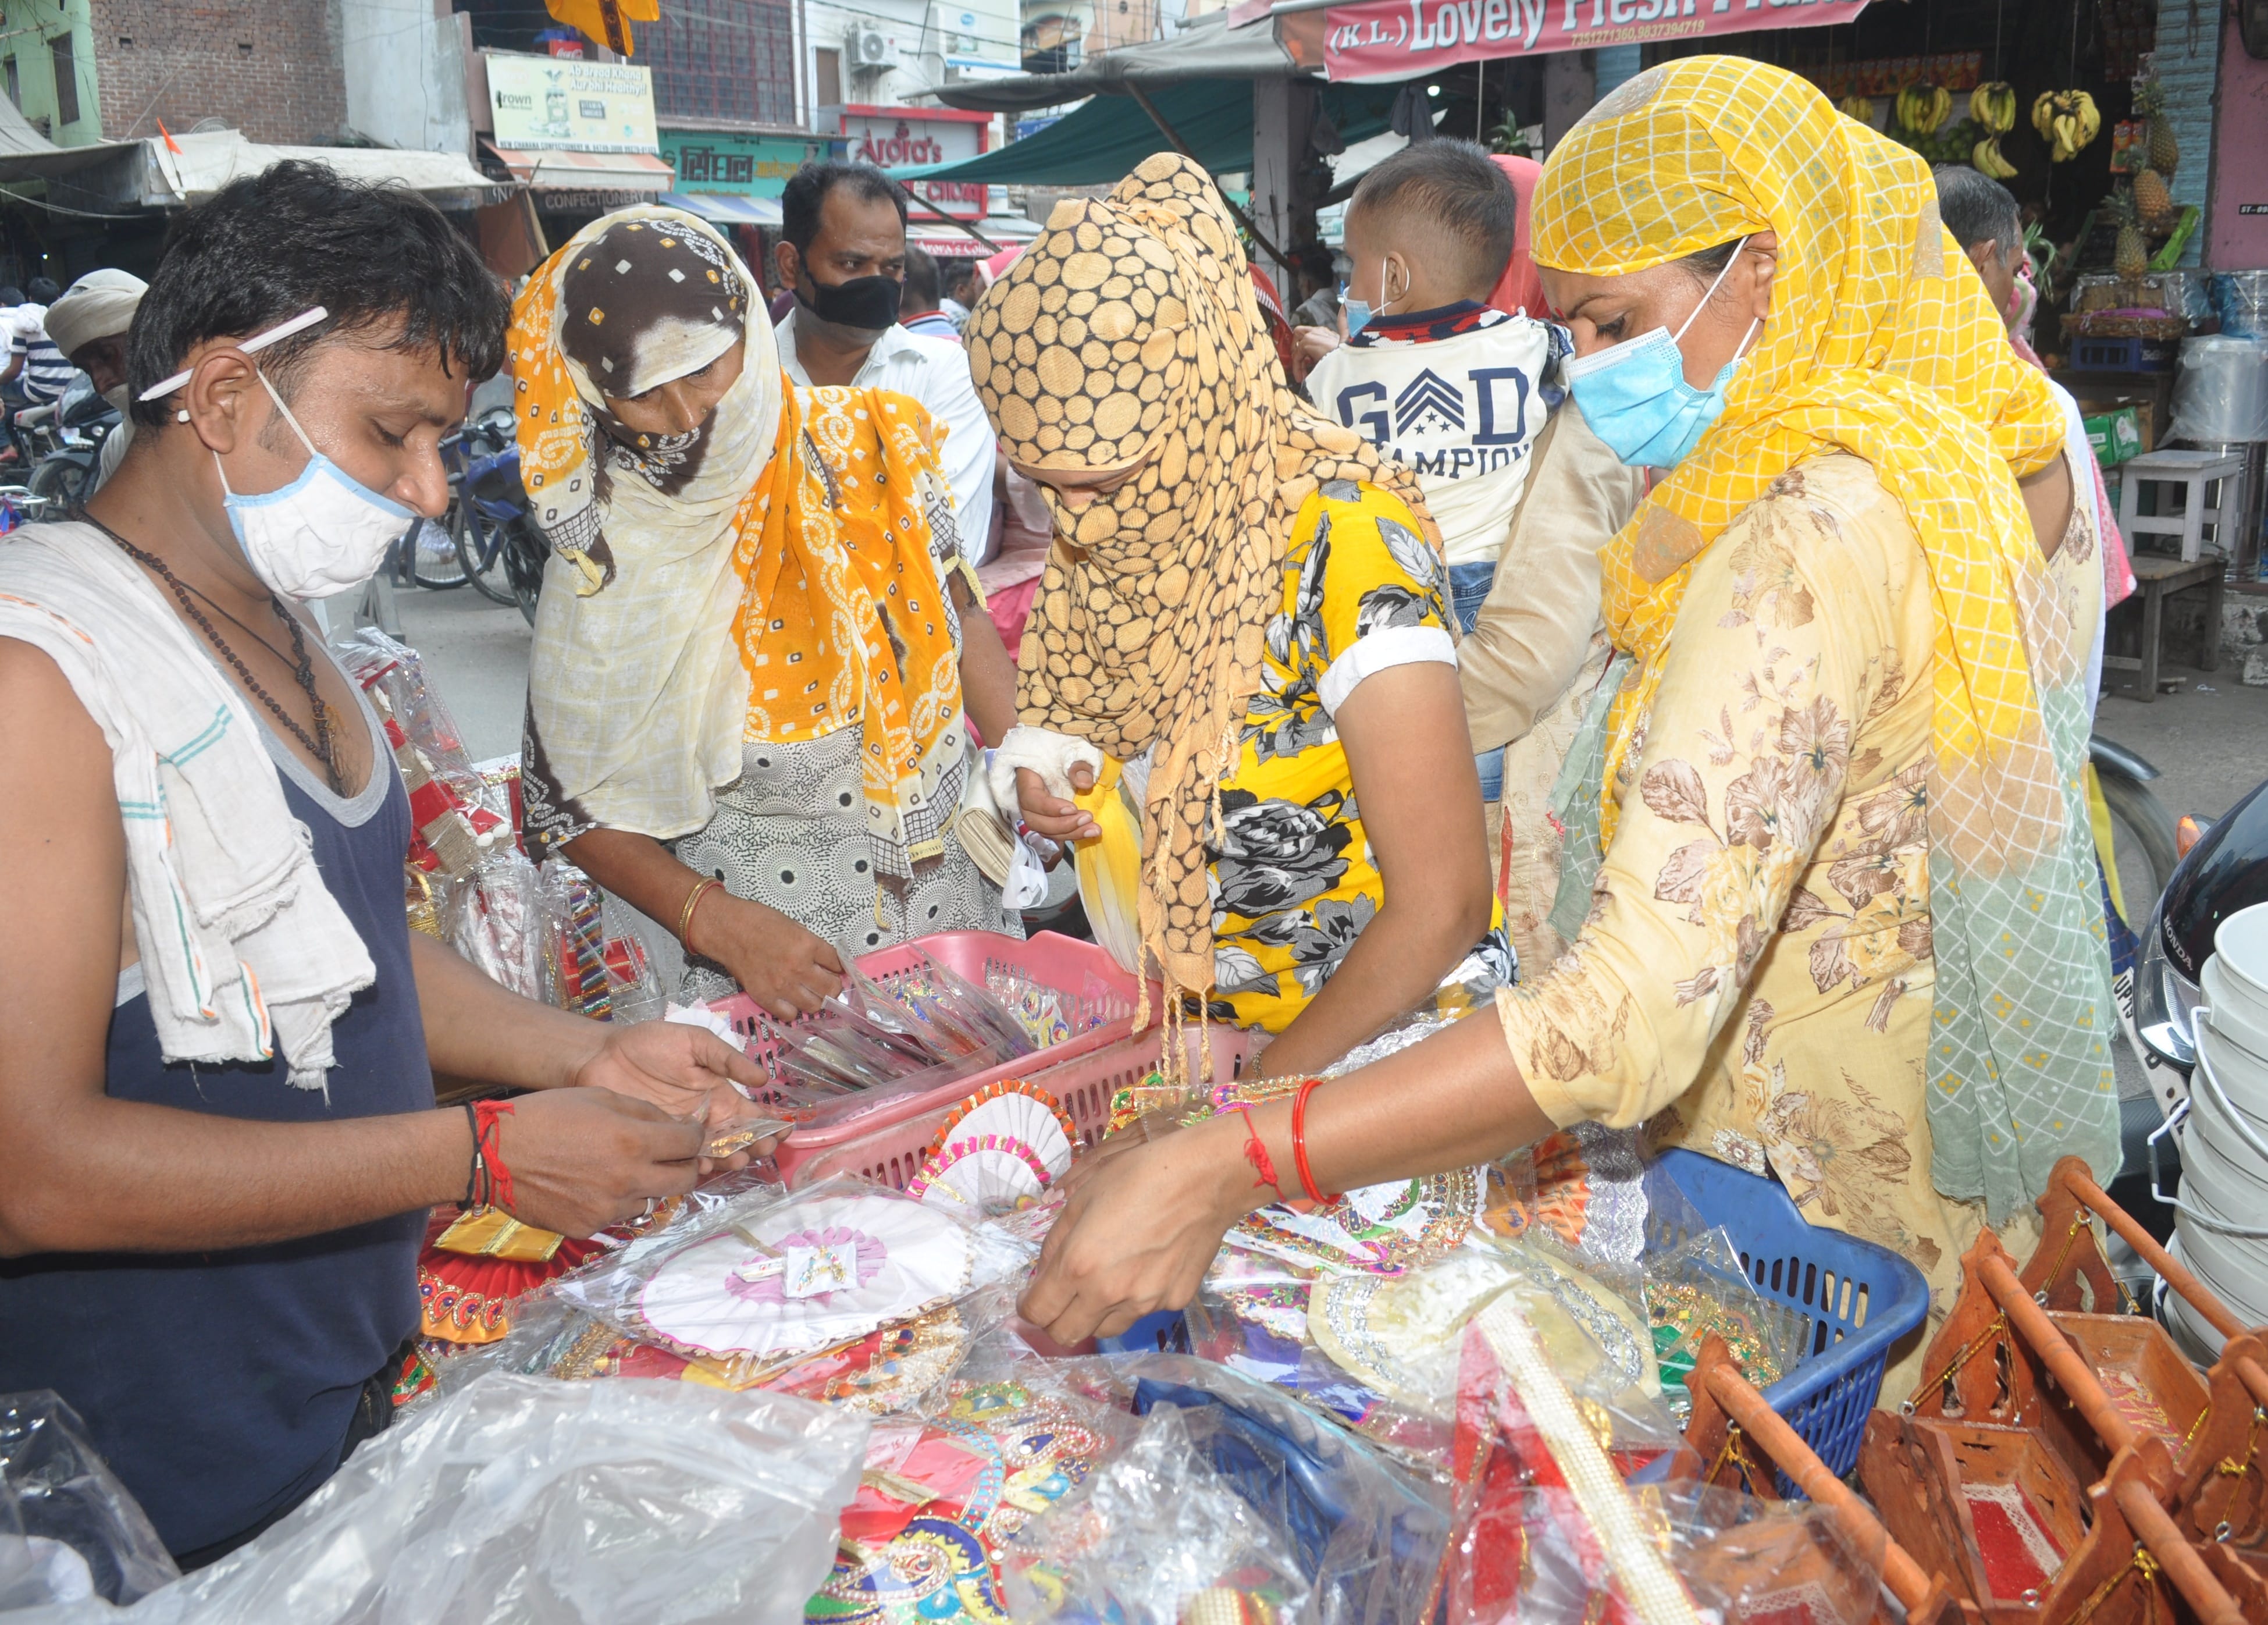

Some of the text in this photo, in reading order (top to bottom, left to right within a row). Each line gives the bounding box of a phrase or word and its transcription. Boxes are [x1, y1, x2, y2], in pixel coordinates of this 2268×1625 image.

[1330, 16, 1407, 56] (K.L.)
[1409, 0, 1546, 51] Lovely
[569, 64, 643, 81] Ab Bread Khana
[496, 91, 532, 108] rown
[856, 117, 942, 165] Arora's
[544, 190, 645, 209] CONFECTIONERY
[917, 240, 962, 256] Arora's
[2163, 913, 2193, 971] HONDA
